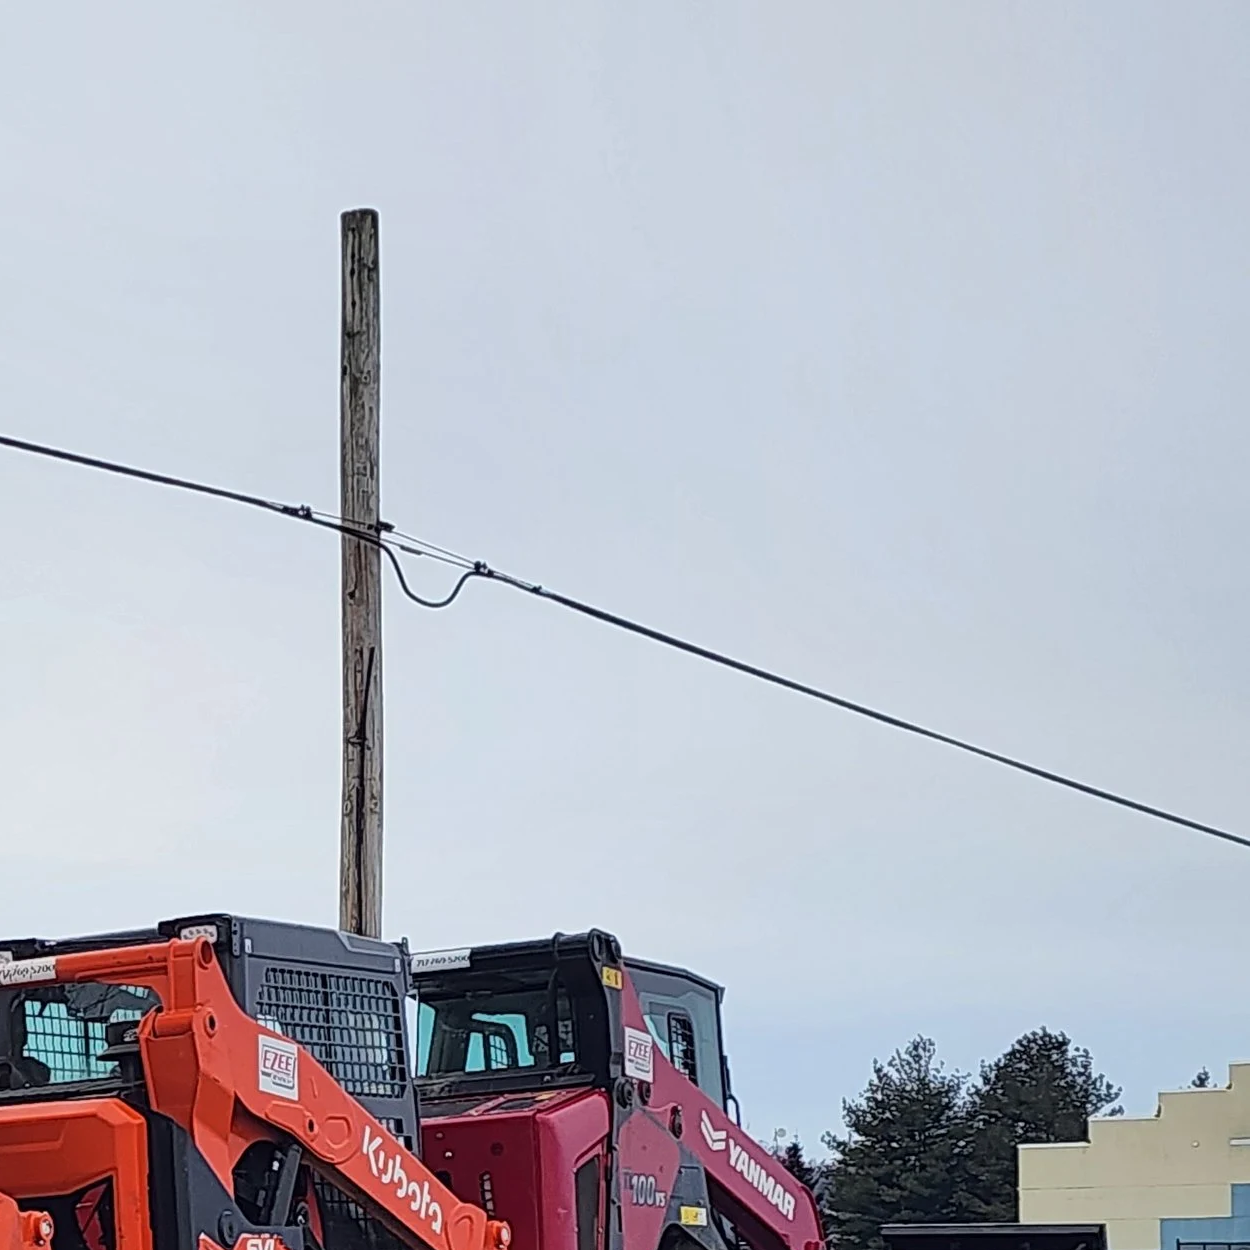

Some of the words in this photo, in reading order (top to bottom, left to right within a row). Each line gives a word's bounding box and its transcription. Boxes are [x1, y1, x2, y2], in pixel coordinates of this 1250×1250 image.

[263, 1050, 293, 1075] EZEE
[629, 1040, 651, 1061] EZEE
[362, 1125, 443, 1235] Kubota
[729, 1138, 796, 1221] YANMAR
